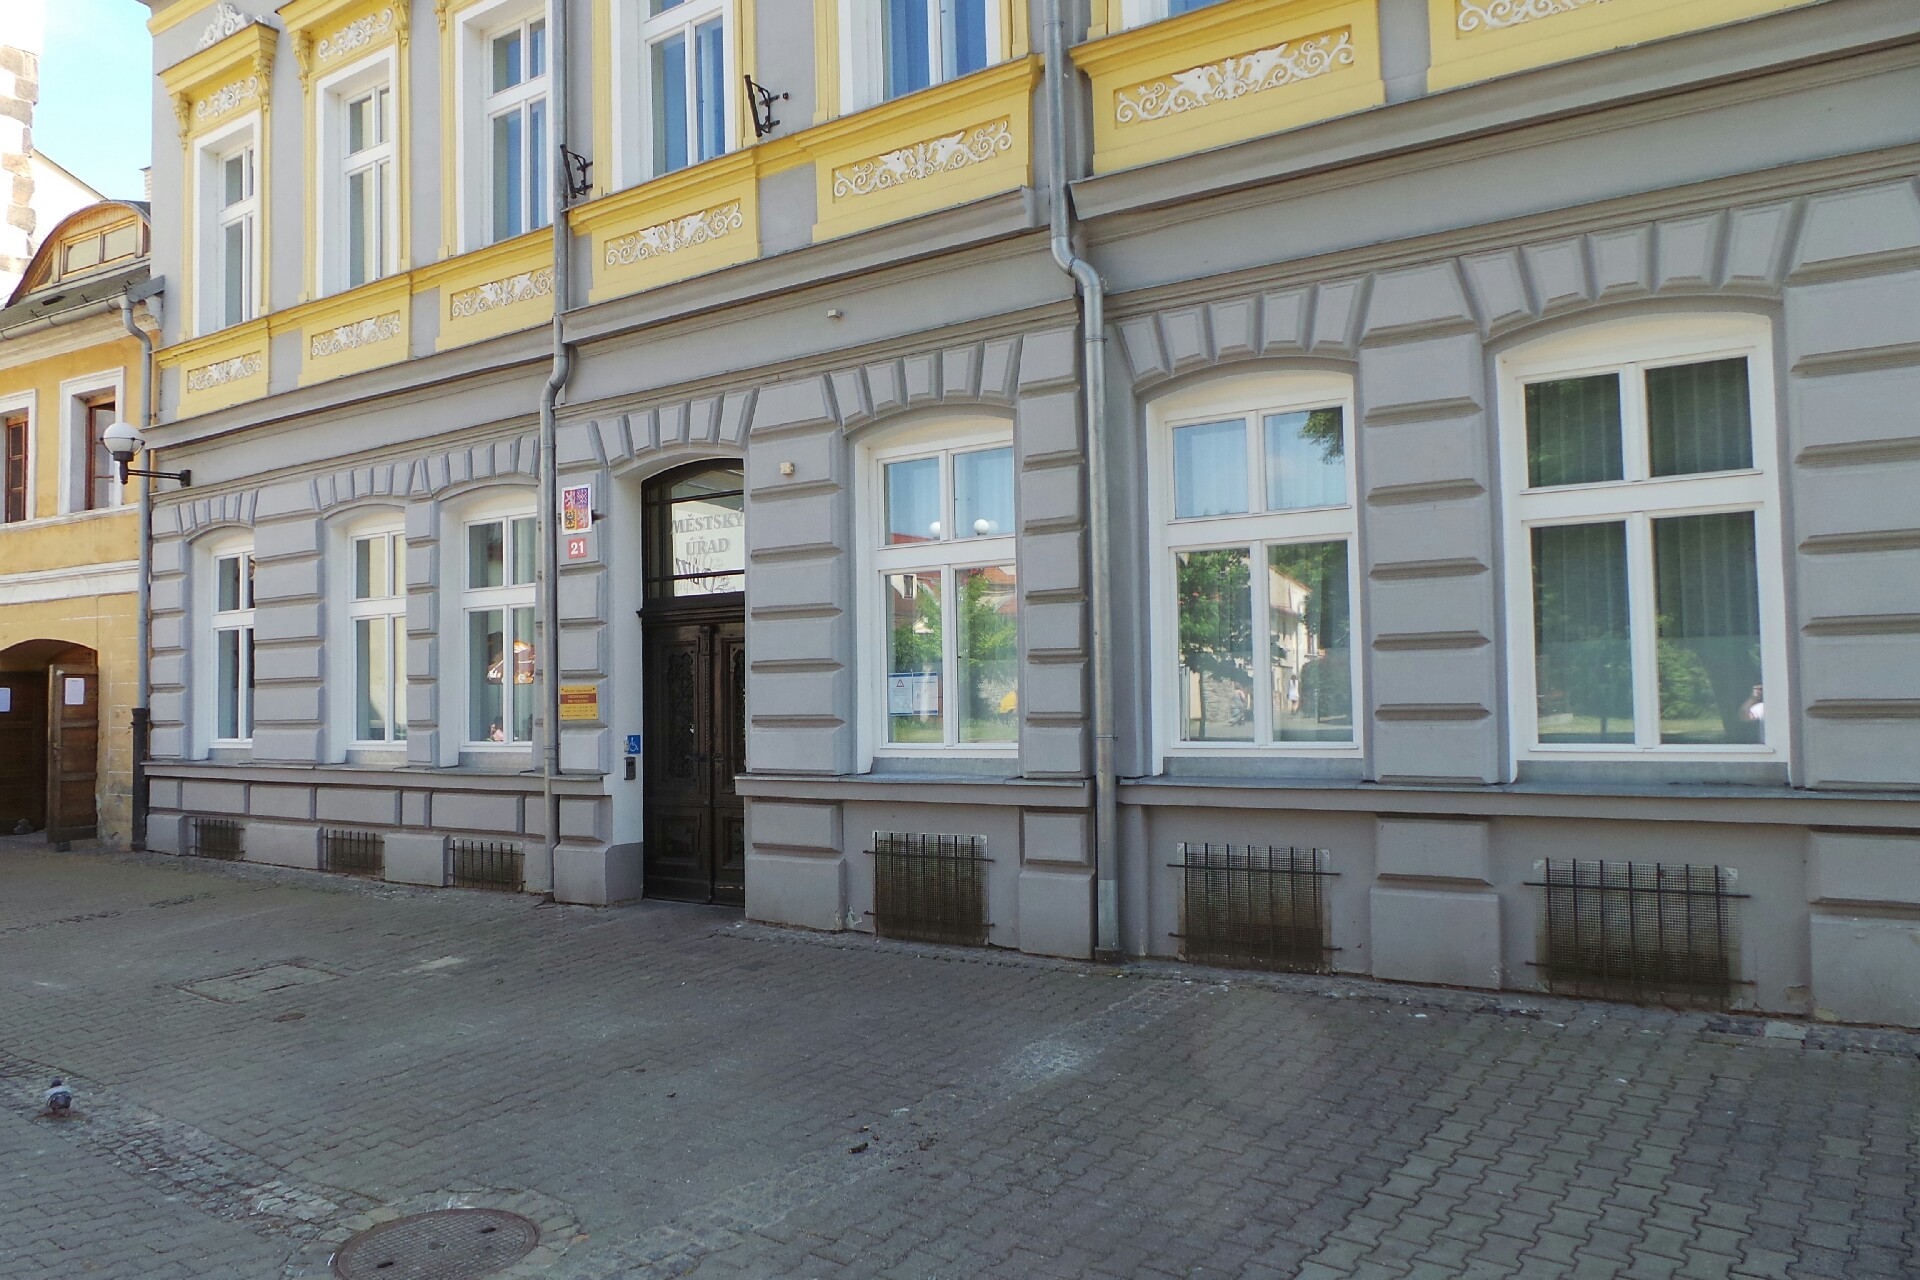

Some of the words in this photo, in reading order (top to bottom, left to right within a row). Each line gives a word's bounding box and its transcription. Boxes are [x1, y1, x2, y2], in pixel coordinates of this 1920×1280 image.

[670, 507, 744, 534] MĚSTSKÝ
[570, 541, 584, 555] 21
[685, 536, 730, 555] ÚŘAD
